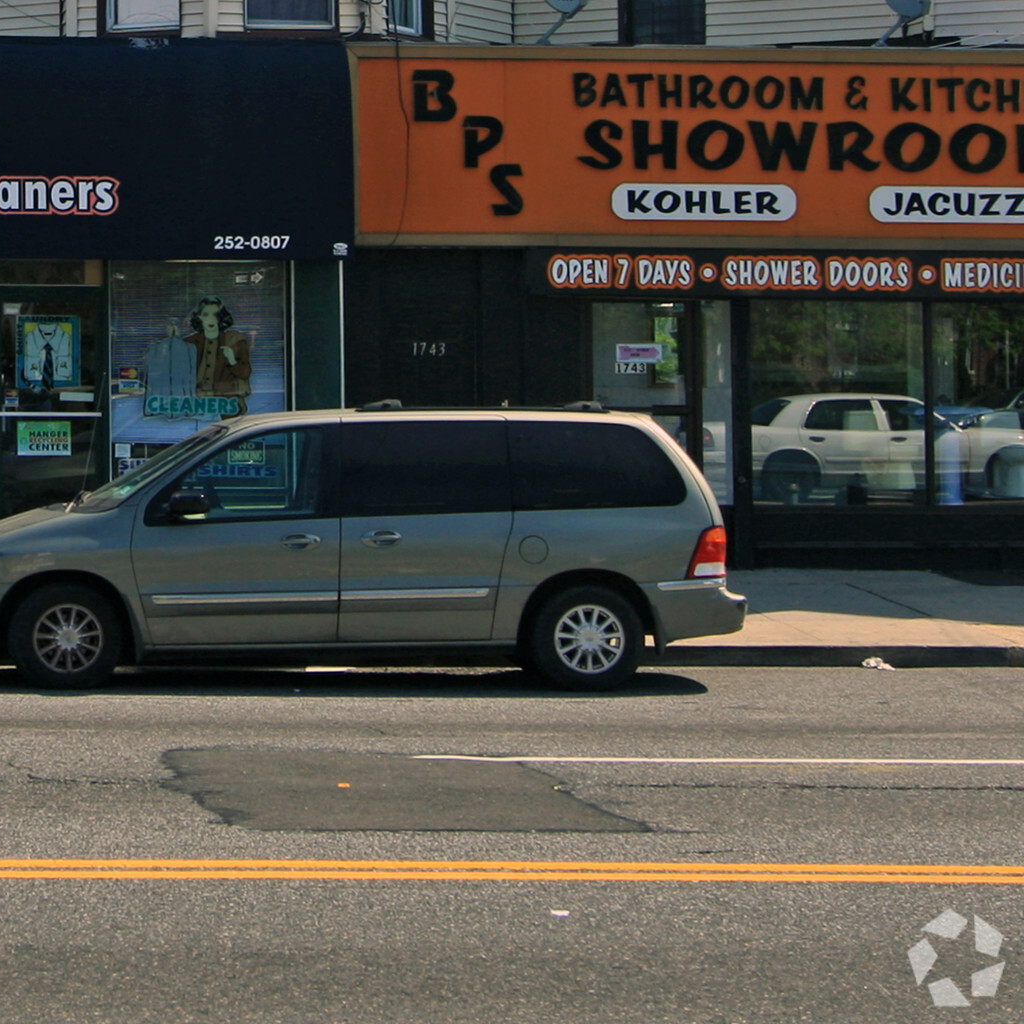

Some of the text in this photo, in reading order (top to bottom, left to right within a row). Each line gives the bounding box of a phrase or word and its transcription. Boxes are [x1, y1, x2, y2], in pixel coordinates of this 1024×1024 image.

[572, 72, 1020, 113] BATHROOM & KITCH
[577, 119, 1024, 175] SHOWROO
[626, 190, 781, 215] KOHLER
[883, 192, 1024, 216] JACUZZ
[214, 235, 291, 250] 252-0807
[551, 258, 692, 286] OPEN 7 DAYS
[724, 260, 910, 288] SHOWER DOORS
[412, 342, 446, 357] 1743
[616, 363, 646, 373] 1743
[147, 396, 241, 415] CLEANERS
[29, 443, 69, 451] CENTER
[198, 465, 277, 477] SHIRTS
